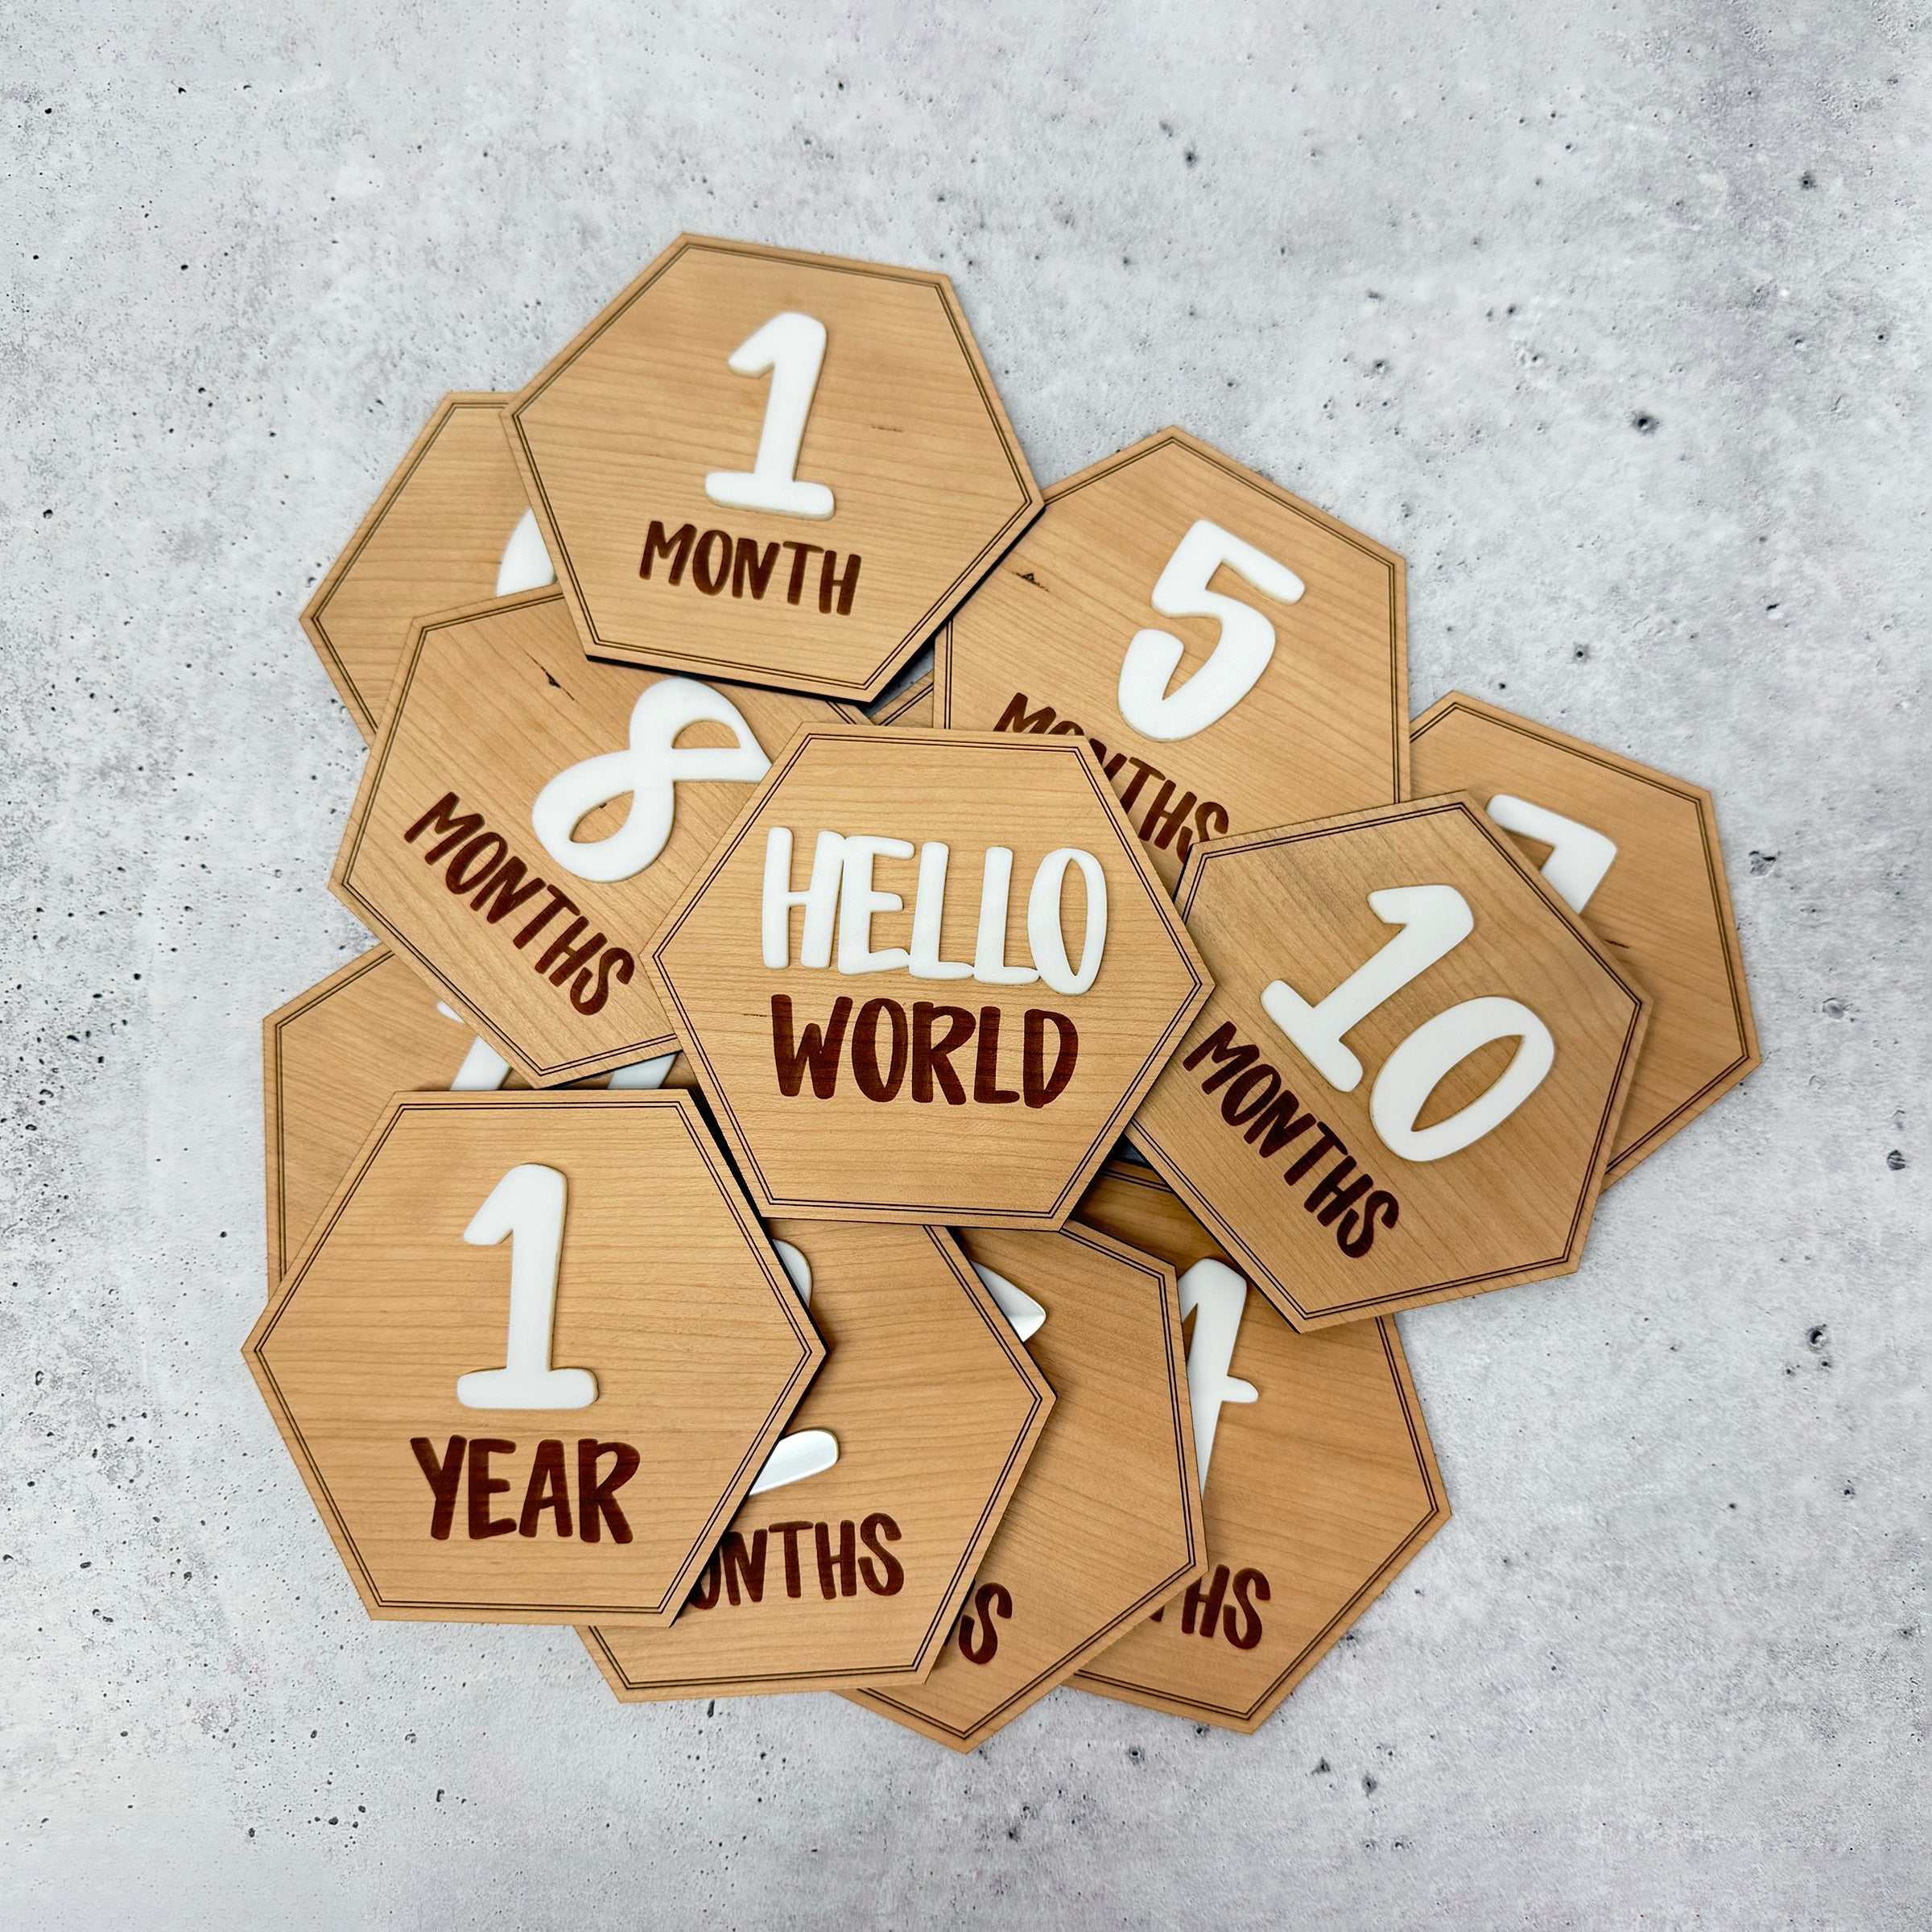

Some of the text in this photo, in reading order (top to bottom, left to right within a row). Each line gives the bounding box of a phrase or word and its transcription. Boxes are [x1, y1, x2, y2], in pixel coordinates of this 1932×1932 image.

[704, 312, 836, 520] 1
[639, 520, 862, 617] MONTH
[1117, 518, 1305, 742] 5
[531, 677, 773, 883] 8
[992, 691, 1229, 865] MTHS
[403, 791, 635, 1016] MONTHS
[762, 827, 1108, 995] HELLO
[770, 993, 1079, 1109] WORLD
[1261, 884, 1555, 1162] 10
[1182, 1020, 1400, 1259] MONTHS
[456, 1163, 599, 1410] 1
[409, 1435, 641, 1545] YEAR
[687, 1512, 905, 1611] ONTHS
